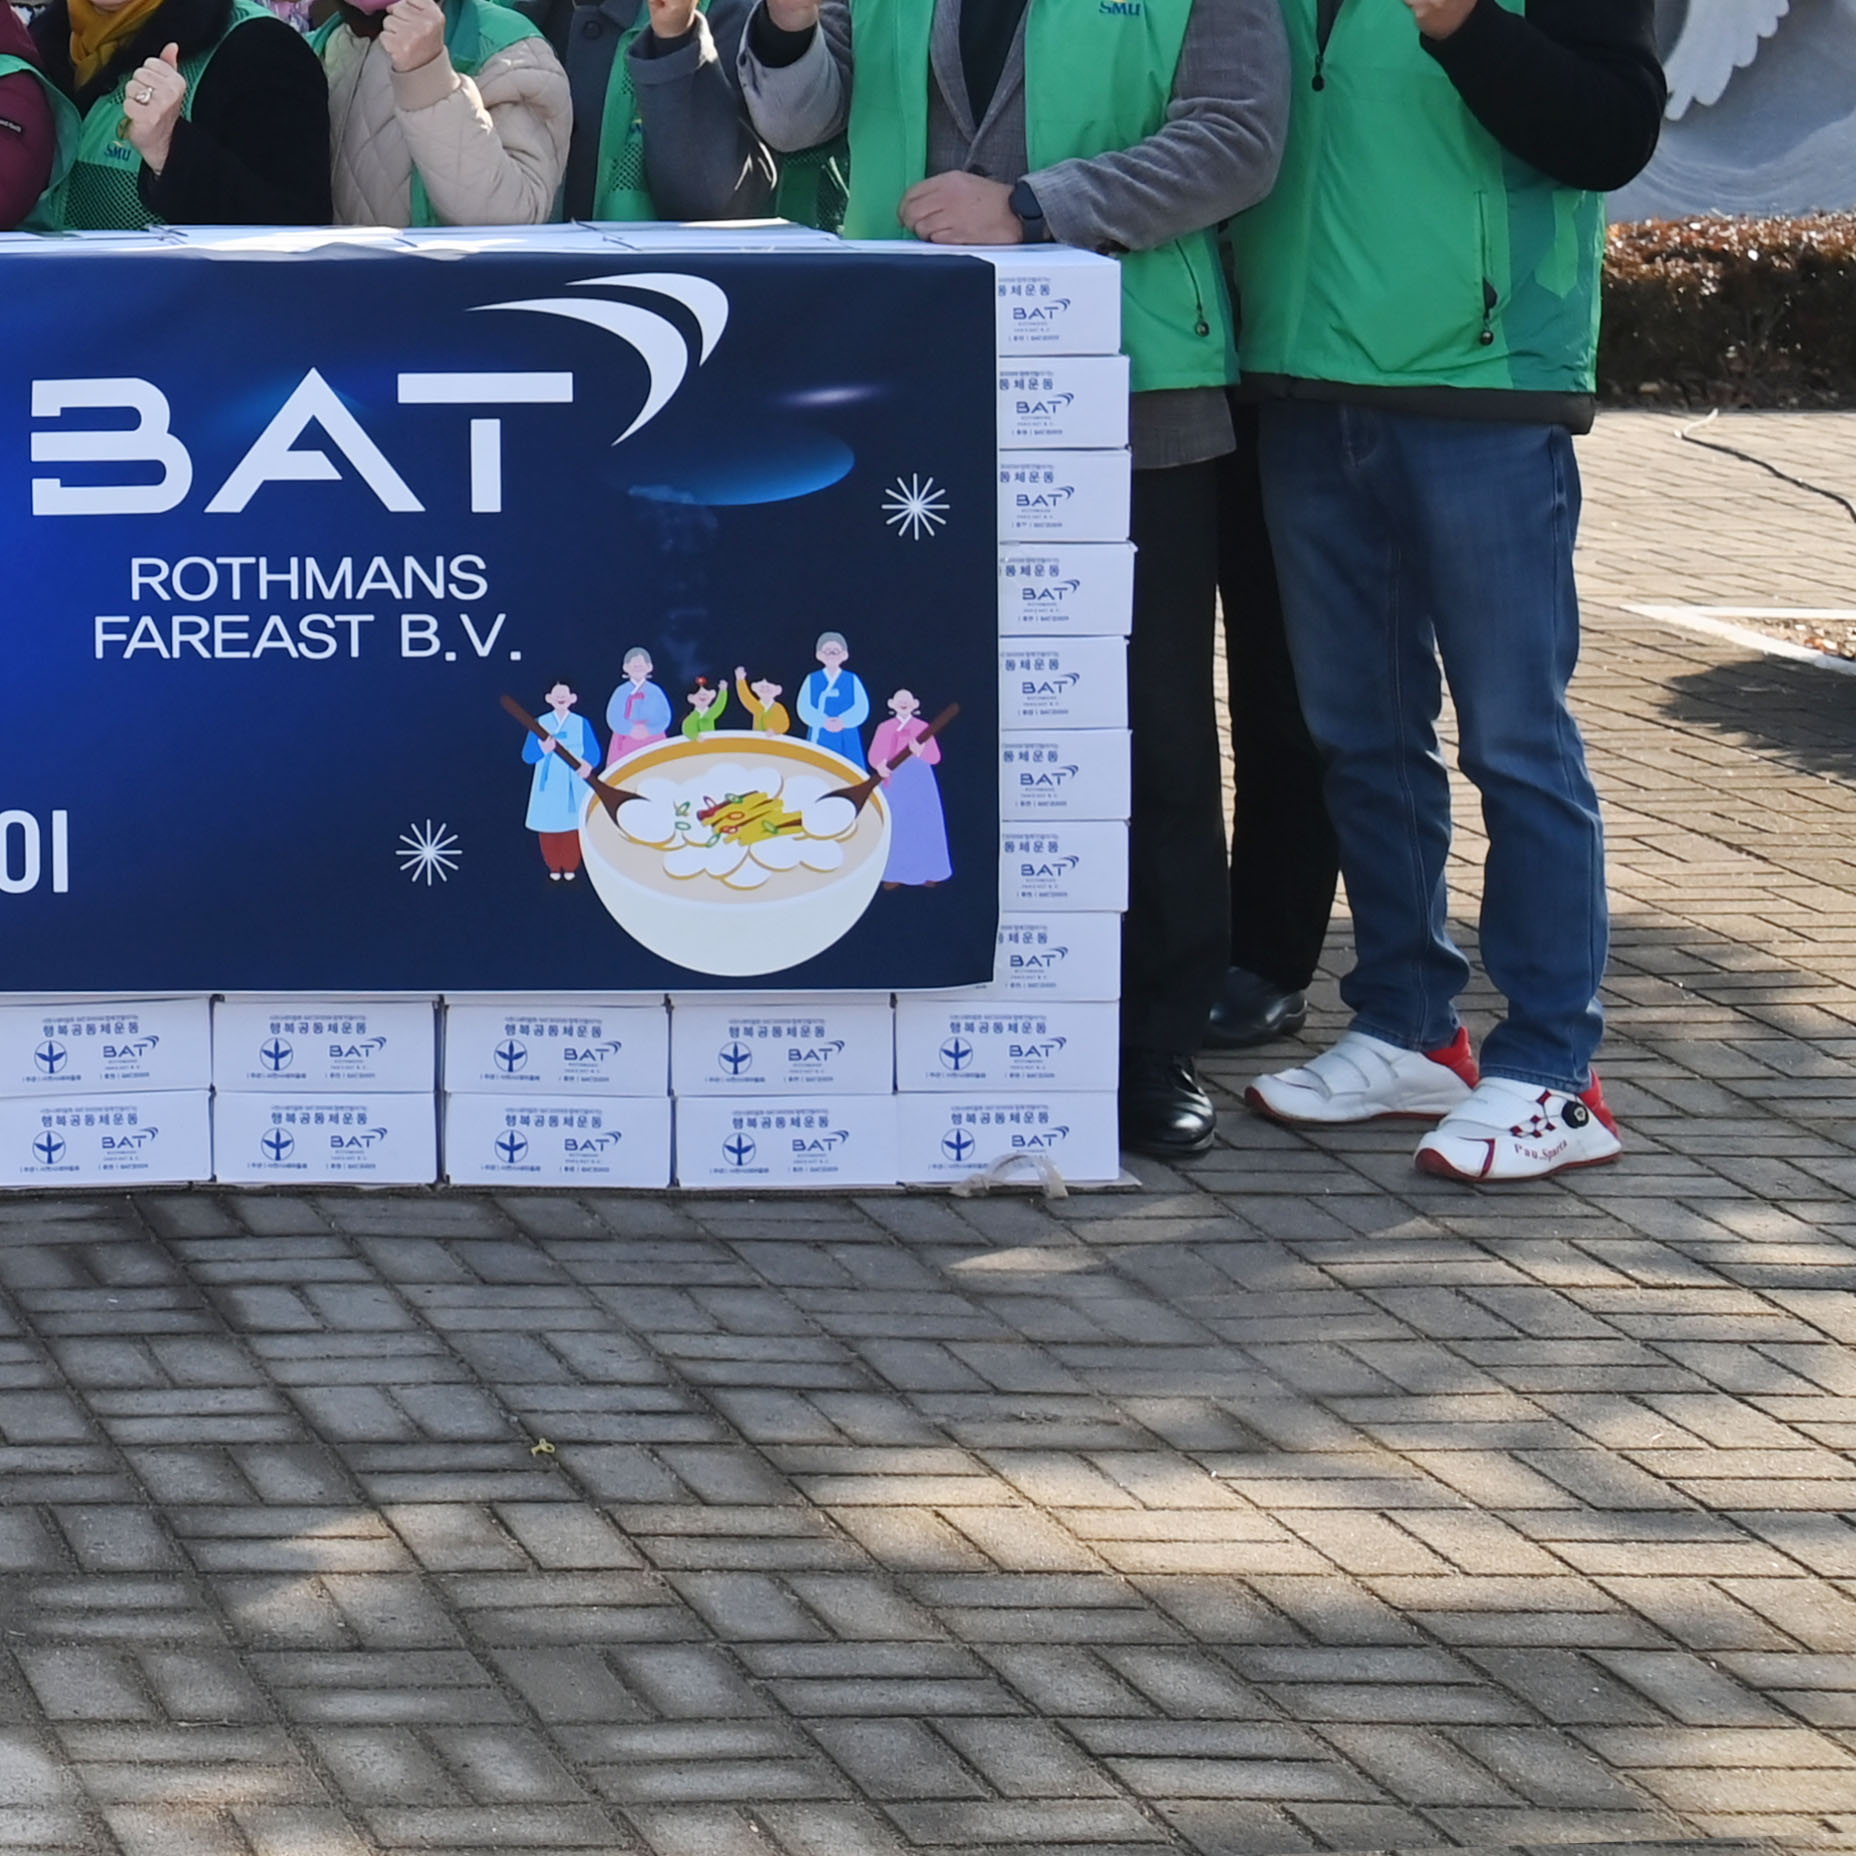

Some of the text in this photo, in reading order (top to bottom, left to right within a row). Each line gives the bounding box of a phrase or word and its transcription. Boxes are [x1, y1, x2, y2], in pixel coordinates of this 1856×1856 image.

[1099, 1, 1141, 17] SMU
[104, 144, 132, 162] SMU
[1013, 306, 1060, 320] BAT
[1016, 400, 1063, 415] BAT
[31, 368, 573, 515] BAT
[1016, 493, 1063, 507] BAT
[130, 554, 488, 602] ROTHMANS
[1022, 586, 1069, 601] BAT
[94, 613, 523, 662] FAREAST B.V.
[1021, 680, 1068, 695] BAT
[1020, 772, 1067, 786] BAT
[1021, 863, 1067, 877] BAT
[1010, 954, 1057, 968] BAT
[41, 1022, 141, 1037] 행복공동체운동
[268, 1020, 368, 1035] 행복공동체운동
[504, 1023, 604, 1038] 행복공동체운동
[727, 1024, 827, 1039] 행복공동체운동
[949, 1020, 1049, 1035] 행복공동체운동
[102, 1040, 148, 1058] BAT
[330, 1041, 373, 1058] BAT
[563, 1044, 609, 1062] BAT
[787, 1044, 833, 1062] BAT
[1008, 1040, 1054, 1058] BAT
[40, 1112, 140, 1127] 행복공동체운동
[270, 1111, 370, 1126] 행복공동체운동
[504, 1113, 604, 1128] 행복공동체운동
[731, 1115, 831, 1130] 행복공동체운동
[950, 1110, 1050, 1125] 행복공동체운동
[101, 1132, 147, 1150] BAT
[329, 1131, 375, 1149] BAT
[565, 1135, 608, 1152] BAT
[791, 1134, 837, 1152] BAT
[1011, 1130, 1057, 1148] BAT
